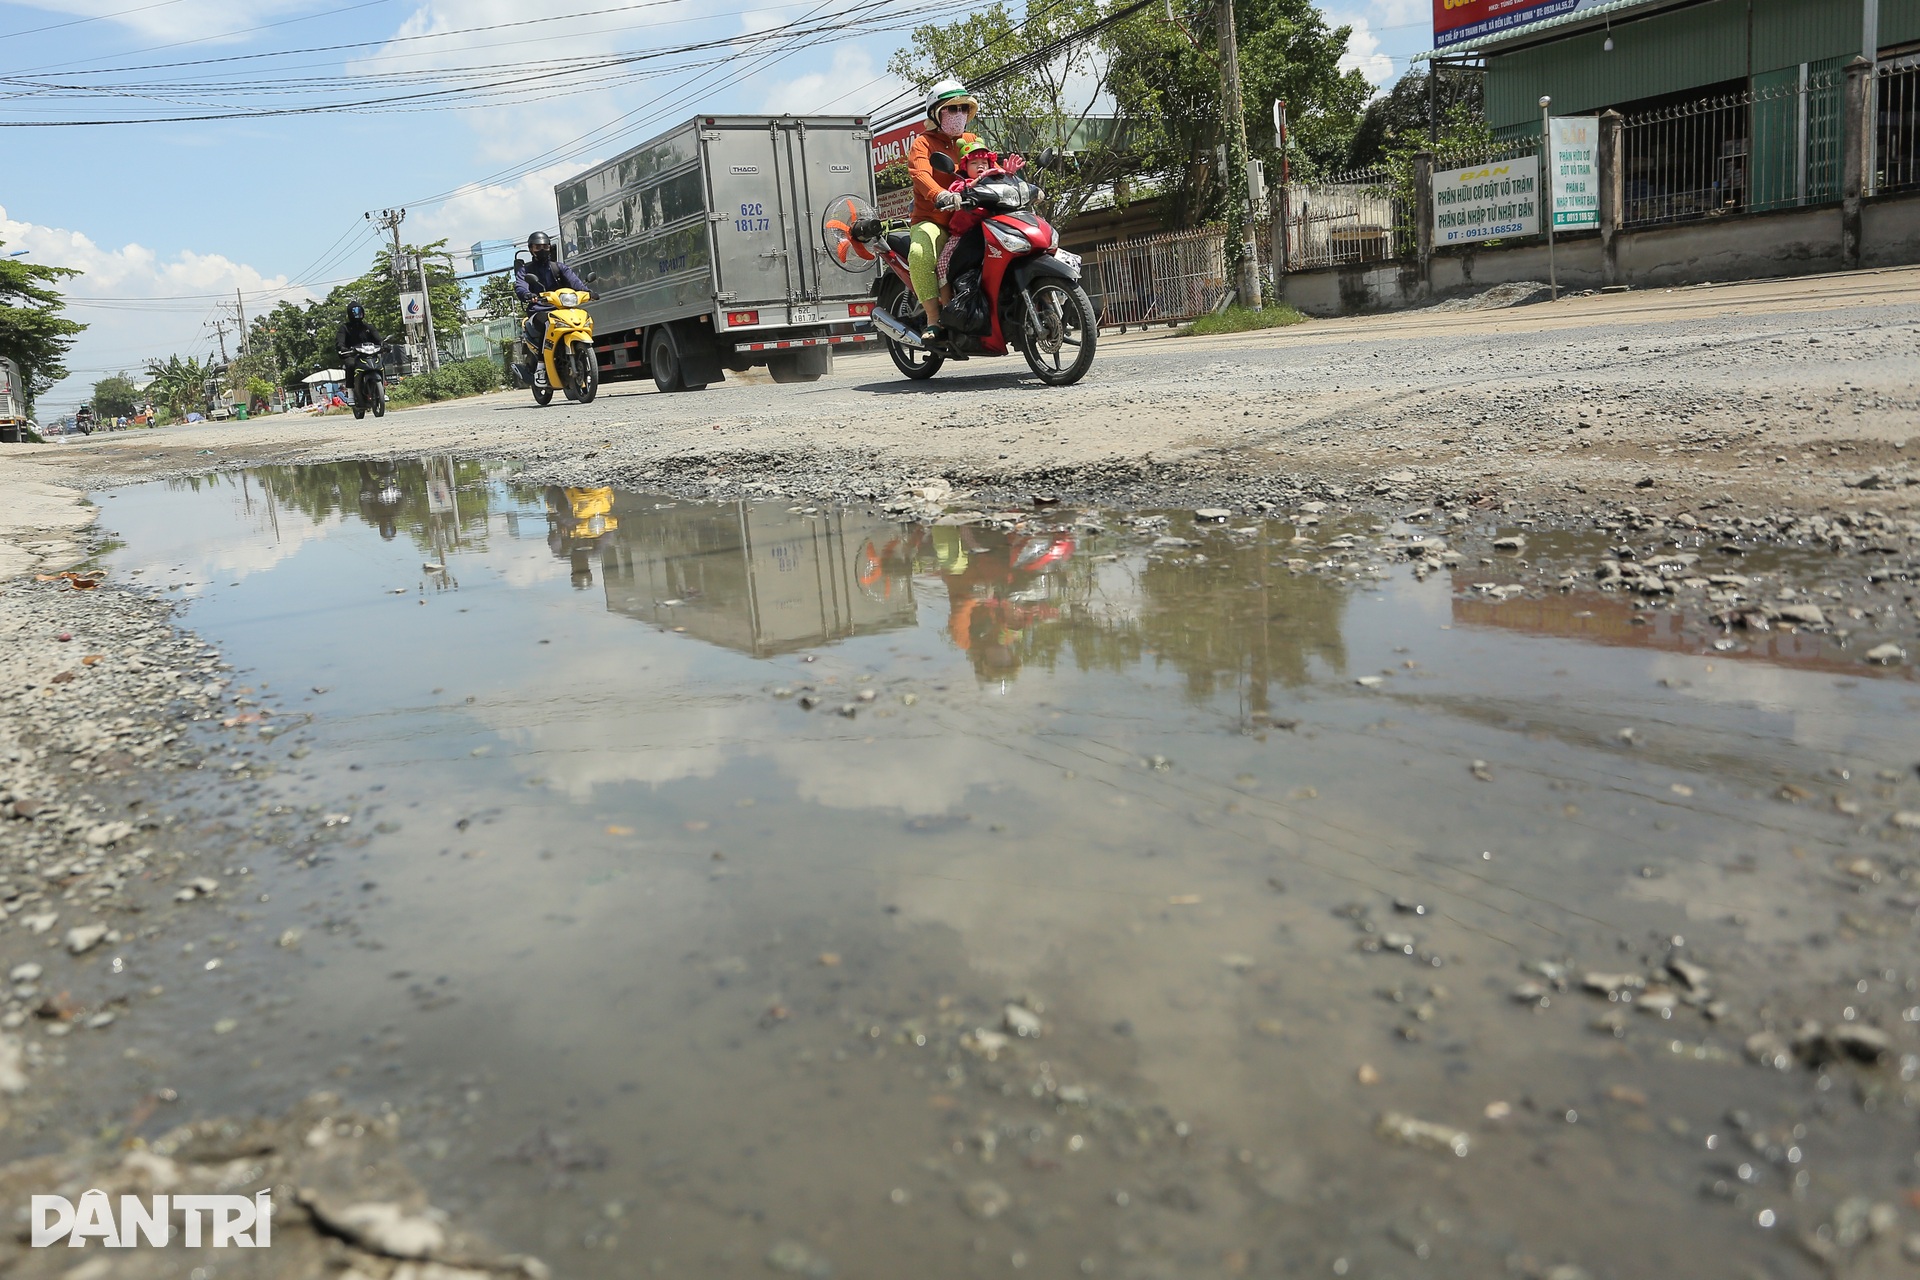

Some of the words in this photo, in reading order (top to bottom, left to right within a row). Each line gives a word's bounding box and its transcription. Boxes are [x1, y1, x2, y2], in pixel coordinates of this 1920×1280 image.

[872, 141, 900, 165] TÙNG
[902, 130, 920, 156] VÂ
[1459, 166, 1510, 181] BÁN
[1438, 187, 1456, 206] PHÂN
[1457, 184, 1472, 203] HỮU
[1473, 183, 1484, 201] CƠ
[1484, 180, 1499, 201] BỘT
[1512, 174, 1534, 195] TRÀM
[741, 203, 763, 216] 62C
[1438, 210, 1456, 229] PHÂN
[1457, 208, 1467, 226] GÀ
[1467, 206, 1486, 227] NHẬP
[1487, 203, 1498, 222] TỪ
[1498, 201, 1517, 222] NHẬT
[1518, 197, 1534, 218] BẢN
[735, 219, 769, 232] 181.77
[1447, 231, 1458, 240] ĐT
[1466, 223, 1522, 238] 0913.168528
